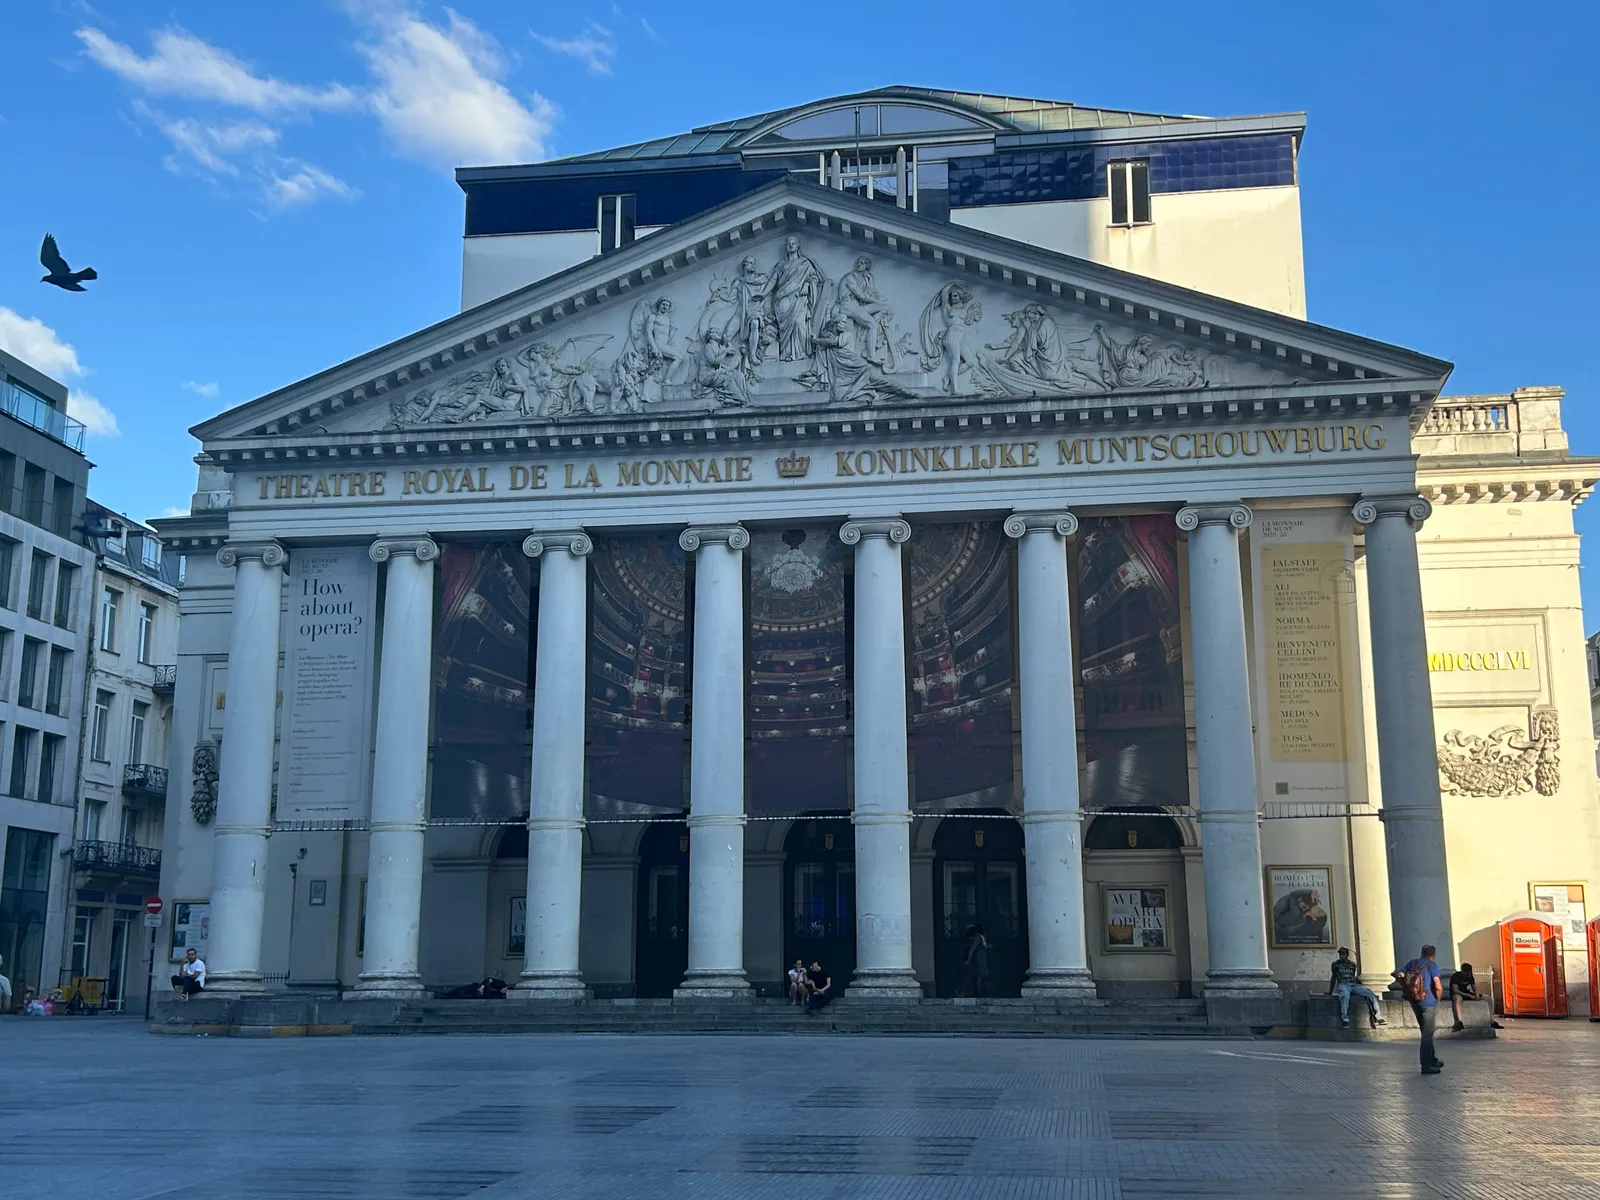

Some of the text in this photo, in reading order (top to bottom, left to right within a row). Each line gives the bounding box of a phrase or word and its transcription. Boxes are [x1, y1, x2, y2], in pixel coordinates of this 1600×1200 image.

[835, 423, 1386, 476] KONINKLIJKE MUNTSCHOUWBURG
[256, 456, 753, 499] THEATRE ROYAL DE LA MONNAIE
[1272, 559, 1317, 567] FALSTAFF
[302, 578, 346, 596] How
[1274, 583, 1290, 591] ALI
[300, 597, 353, 616] about
[300, 616, 362, 642] opera?
[1277, 640, 1335, 649] BENVENUTO
[1277, 648, 1316, 656] CELLINI
[1294, 680, 1304, 688] DI
[1280, 709, 1320, 717] MEDUSA
[1112, 893, 1138, 905] WE
[1132, 906, 1161, 917] ARE
[1112, 917, 1163, 929] OPERA
